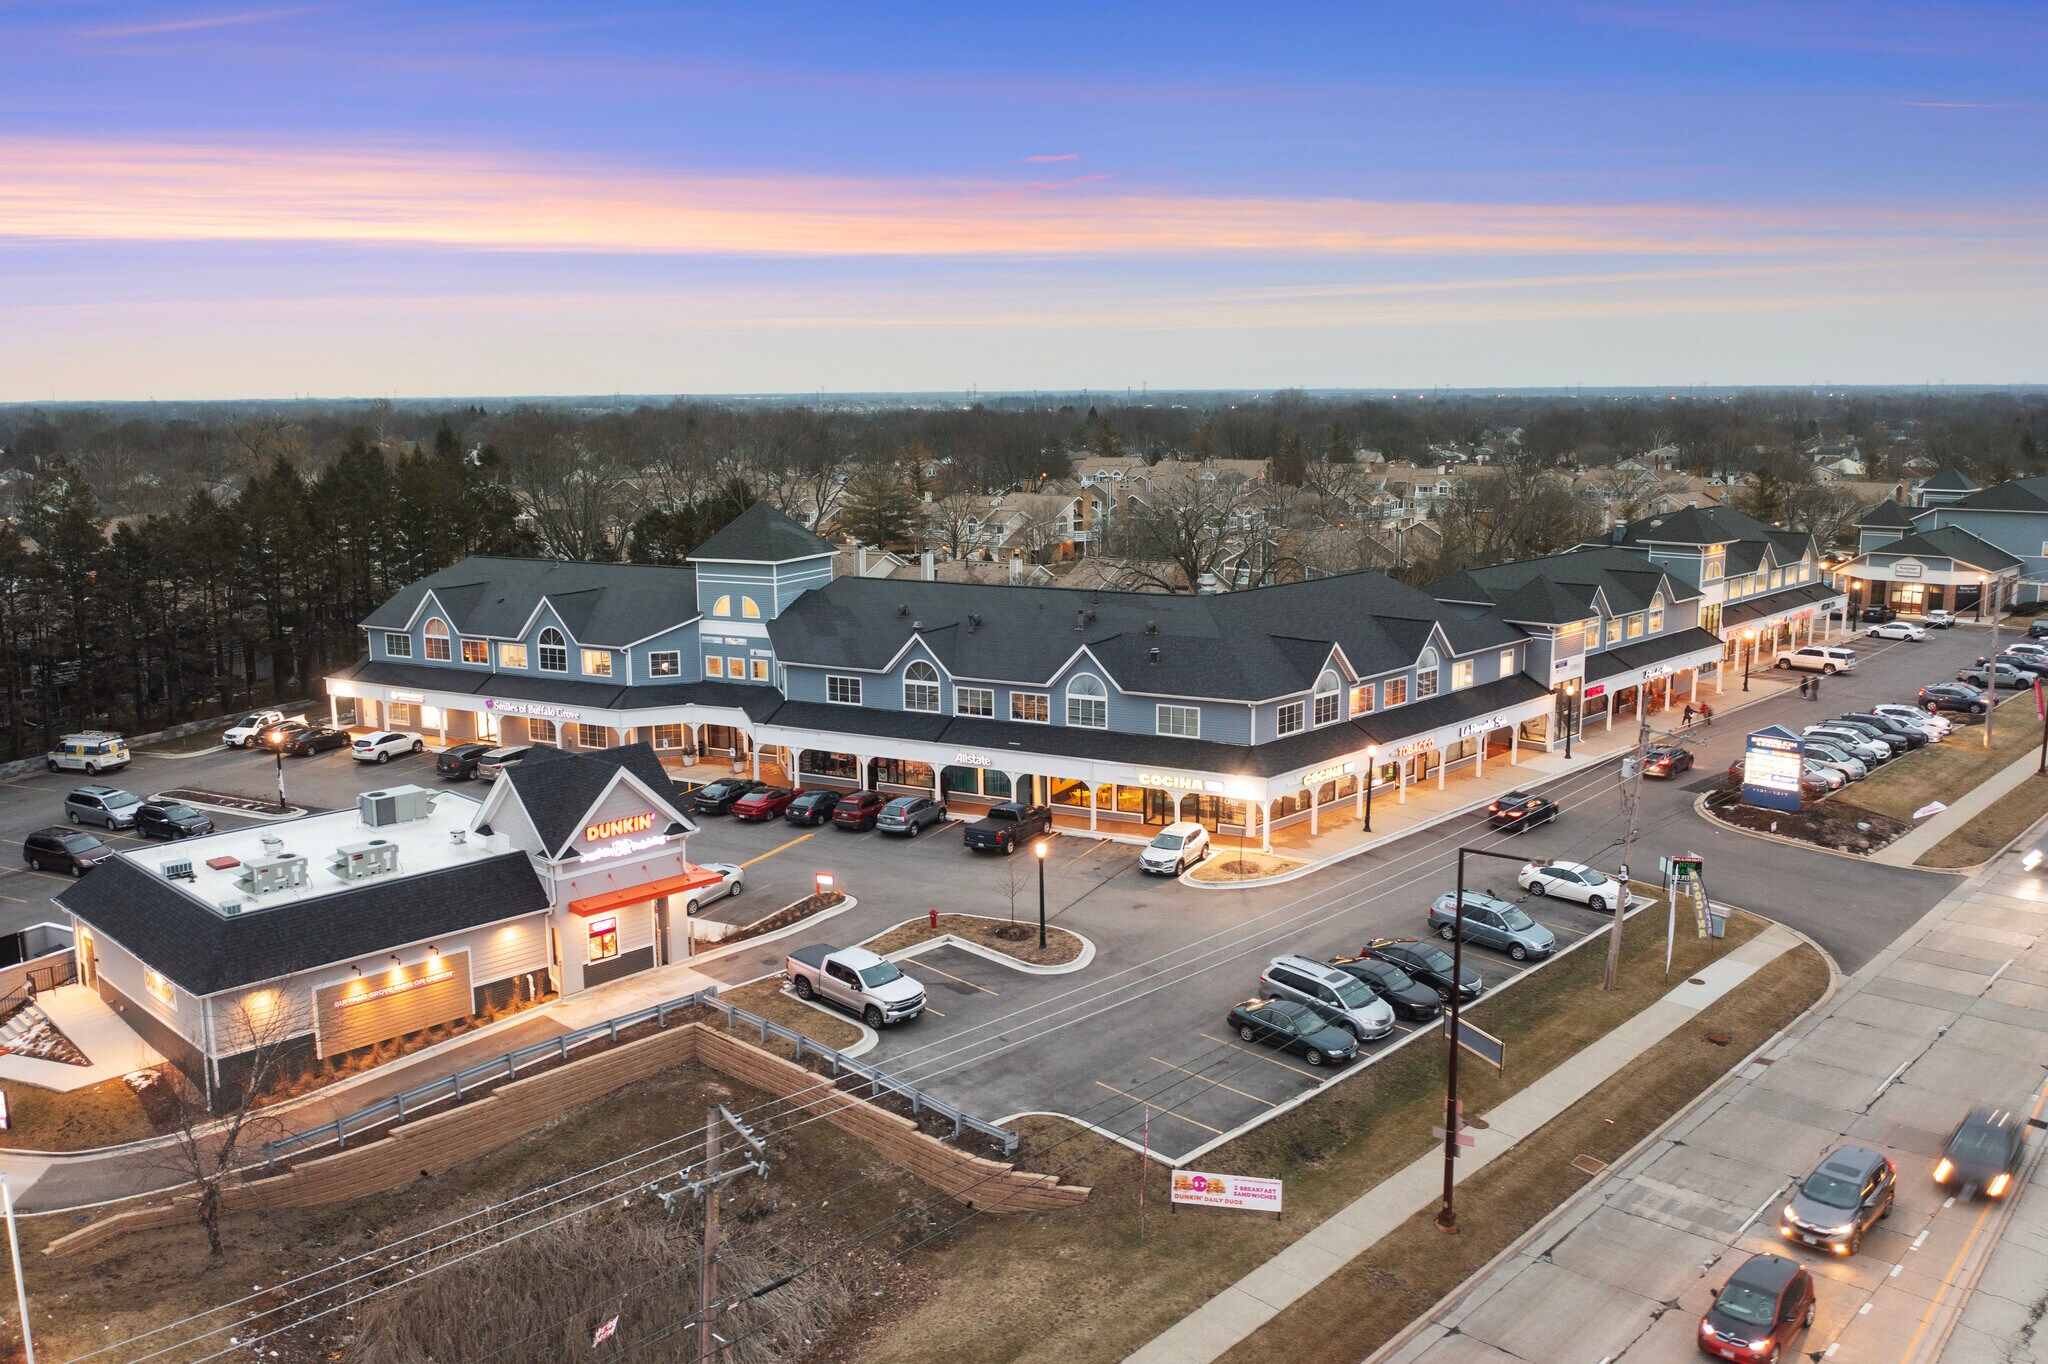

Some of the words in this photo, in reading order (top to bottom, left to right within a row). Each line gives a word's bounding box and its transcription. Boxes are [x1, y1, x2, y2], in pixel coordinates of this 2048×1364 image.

[493, 701, 518, 713] Smiles
[519, 704, 527, 713] of
[528, 705, 555, 717] Buffalo
[556, 708, 580, 719] Grove
[1397, 738, 1435, 758] TOBACCO
[955, 752, 991, 766] Allstate
[1138, 772, 1204, 791] COCINA
[1302, 764, 1344, 786] COCINA
[1224, 799, 1239, 807] OPEN
[586, 812, 656, 842] DUNKIN'
[334, 993, 368, 1008] BUFFALO
[368, 987, 394, 998] GROVE
[394, 981, 414, 993] RUNS
[414, 978, 427, 986] ON
[1233, 1191, 1277, 1200] SANDWICHES
[1240, 1185, 1277, 1194] BREAKFAST
[1204, 1196, 1223, 1204] DAILY
